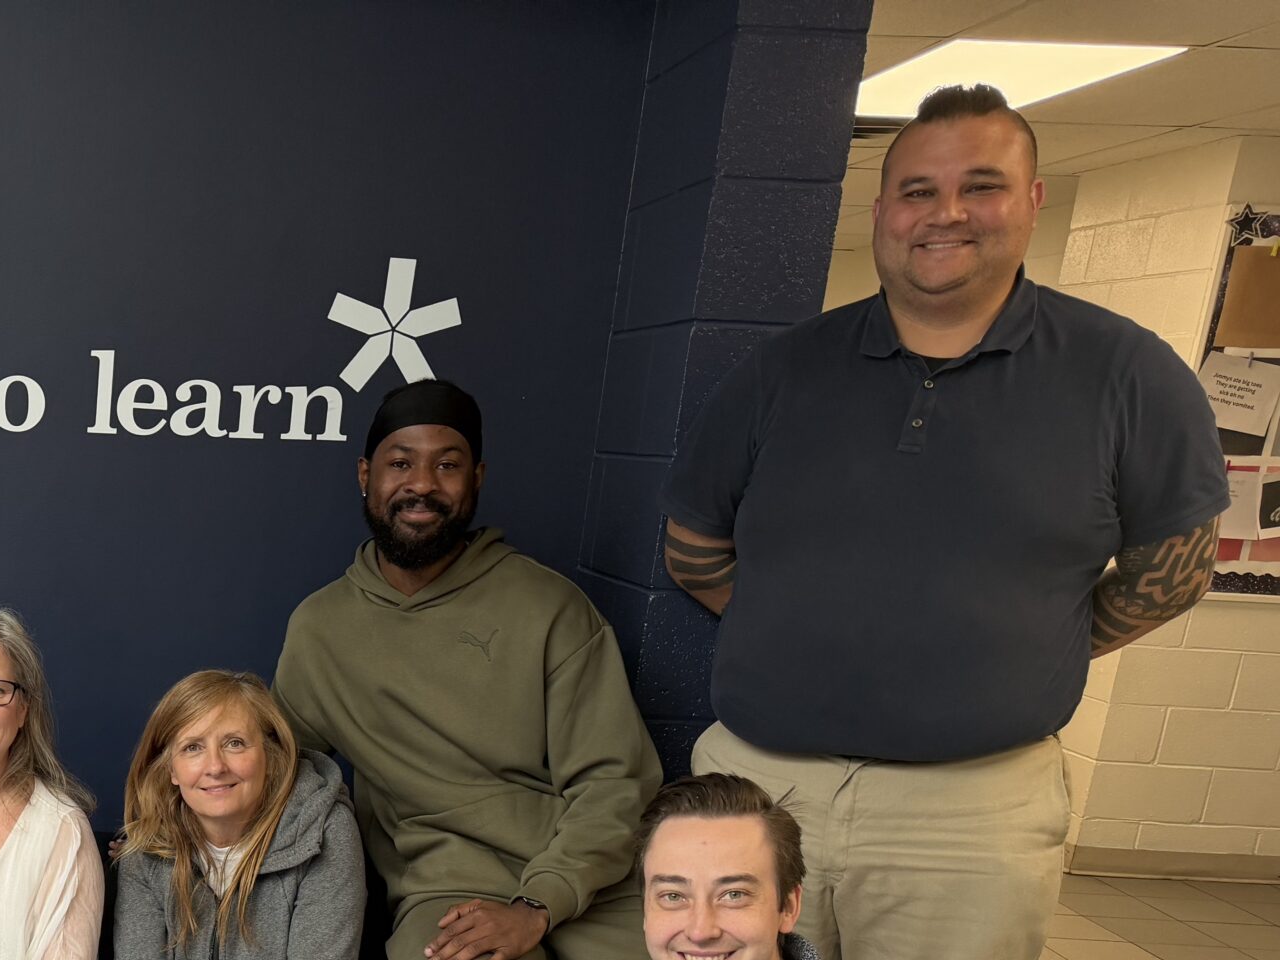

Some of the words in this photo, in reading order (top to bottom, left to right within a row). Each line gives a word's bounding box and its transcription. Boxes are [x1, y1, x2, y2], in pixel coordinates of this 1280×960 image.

[1215, 380, 1228, 389] They
[1236, 385, 1257, 395] getting
[1241, 379, 1251, 387] big
[86, 349, 348, 442] learn
[1220, 397, 1232, 406] they
